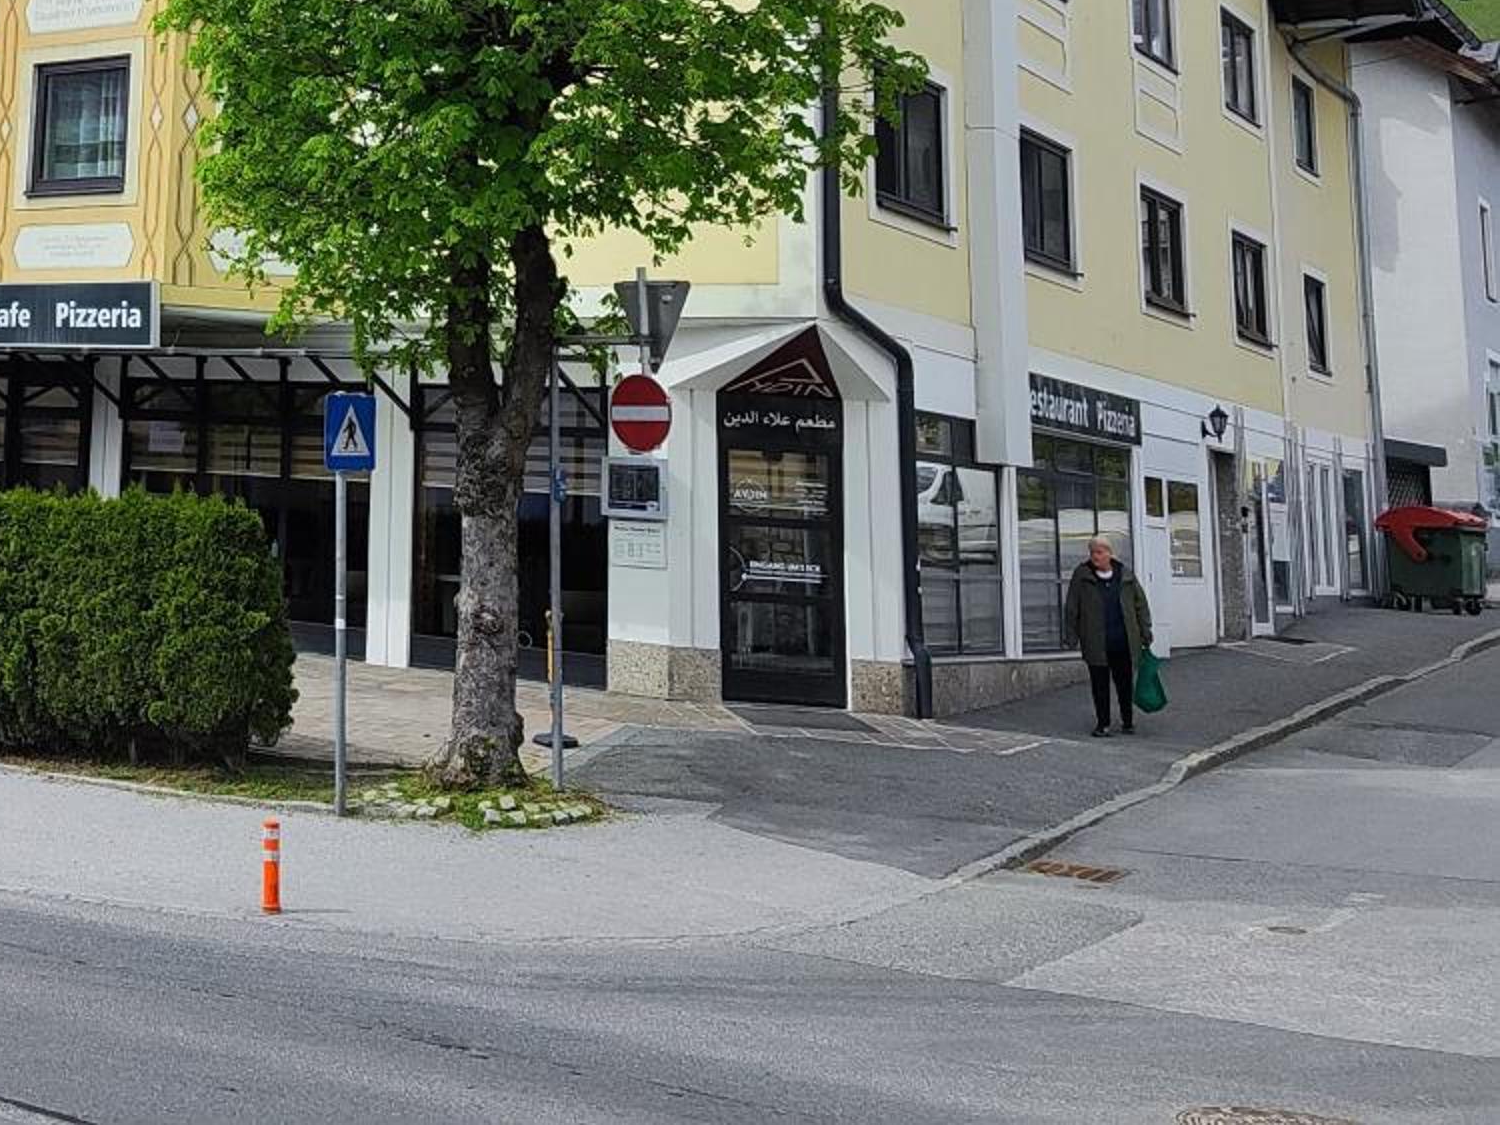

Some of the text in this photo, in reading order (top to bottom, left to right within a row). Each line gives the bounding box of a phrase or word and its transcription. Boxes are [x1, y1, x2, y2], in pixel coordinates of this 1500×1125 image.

[55, 300, 141, 328] Pizzeria
[723, 410, 836, 434] مطعم علاء الدين
[1030, 386, 1136, 437] estaurant Pizzeria
